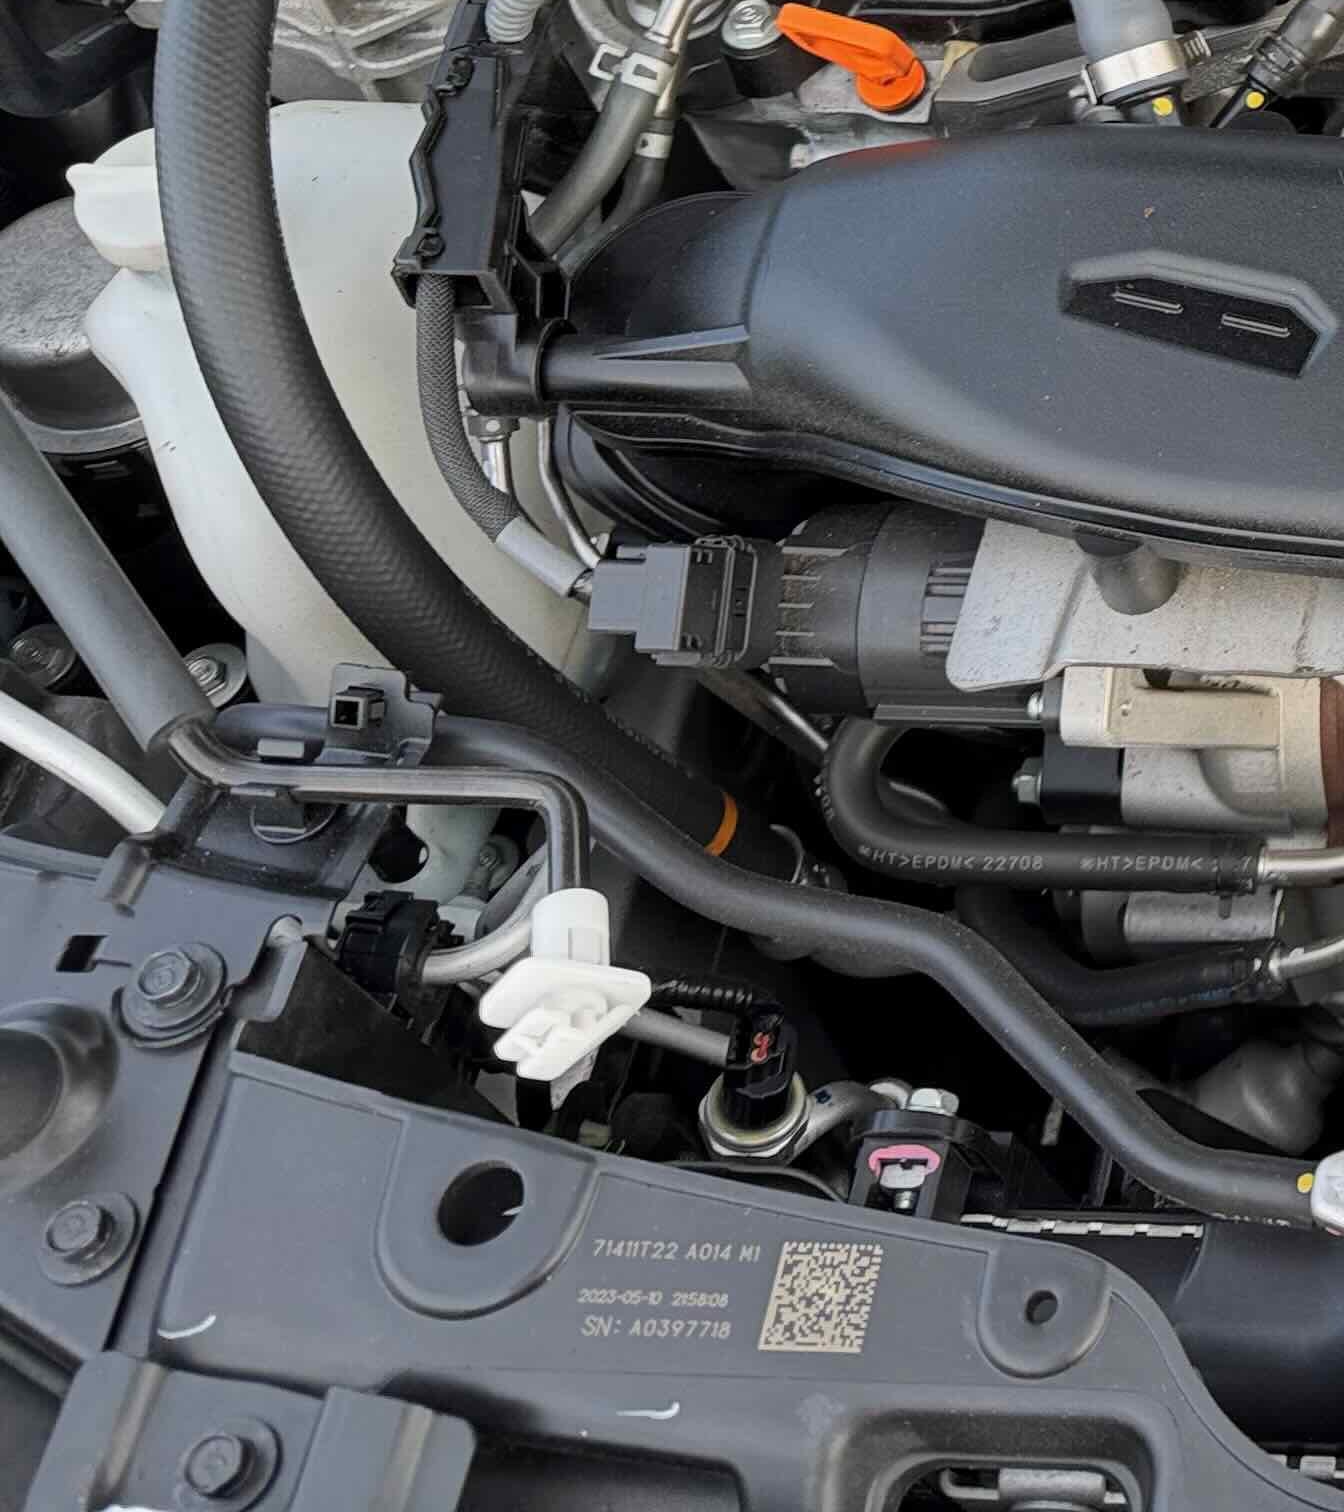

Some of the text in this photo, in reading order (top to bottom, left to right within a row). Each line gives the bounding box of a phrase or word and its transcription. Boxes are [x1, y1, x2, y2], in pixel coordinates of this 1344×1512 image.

[685, 1242, 732, 1261] A014
[577, 1288, 664, 1305] 2023-05-10
[581, 1315, 731, 1339] SN: A0397718
